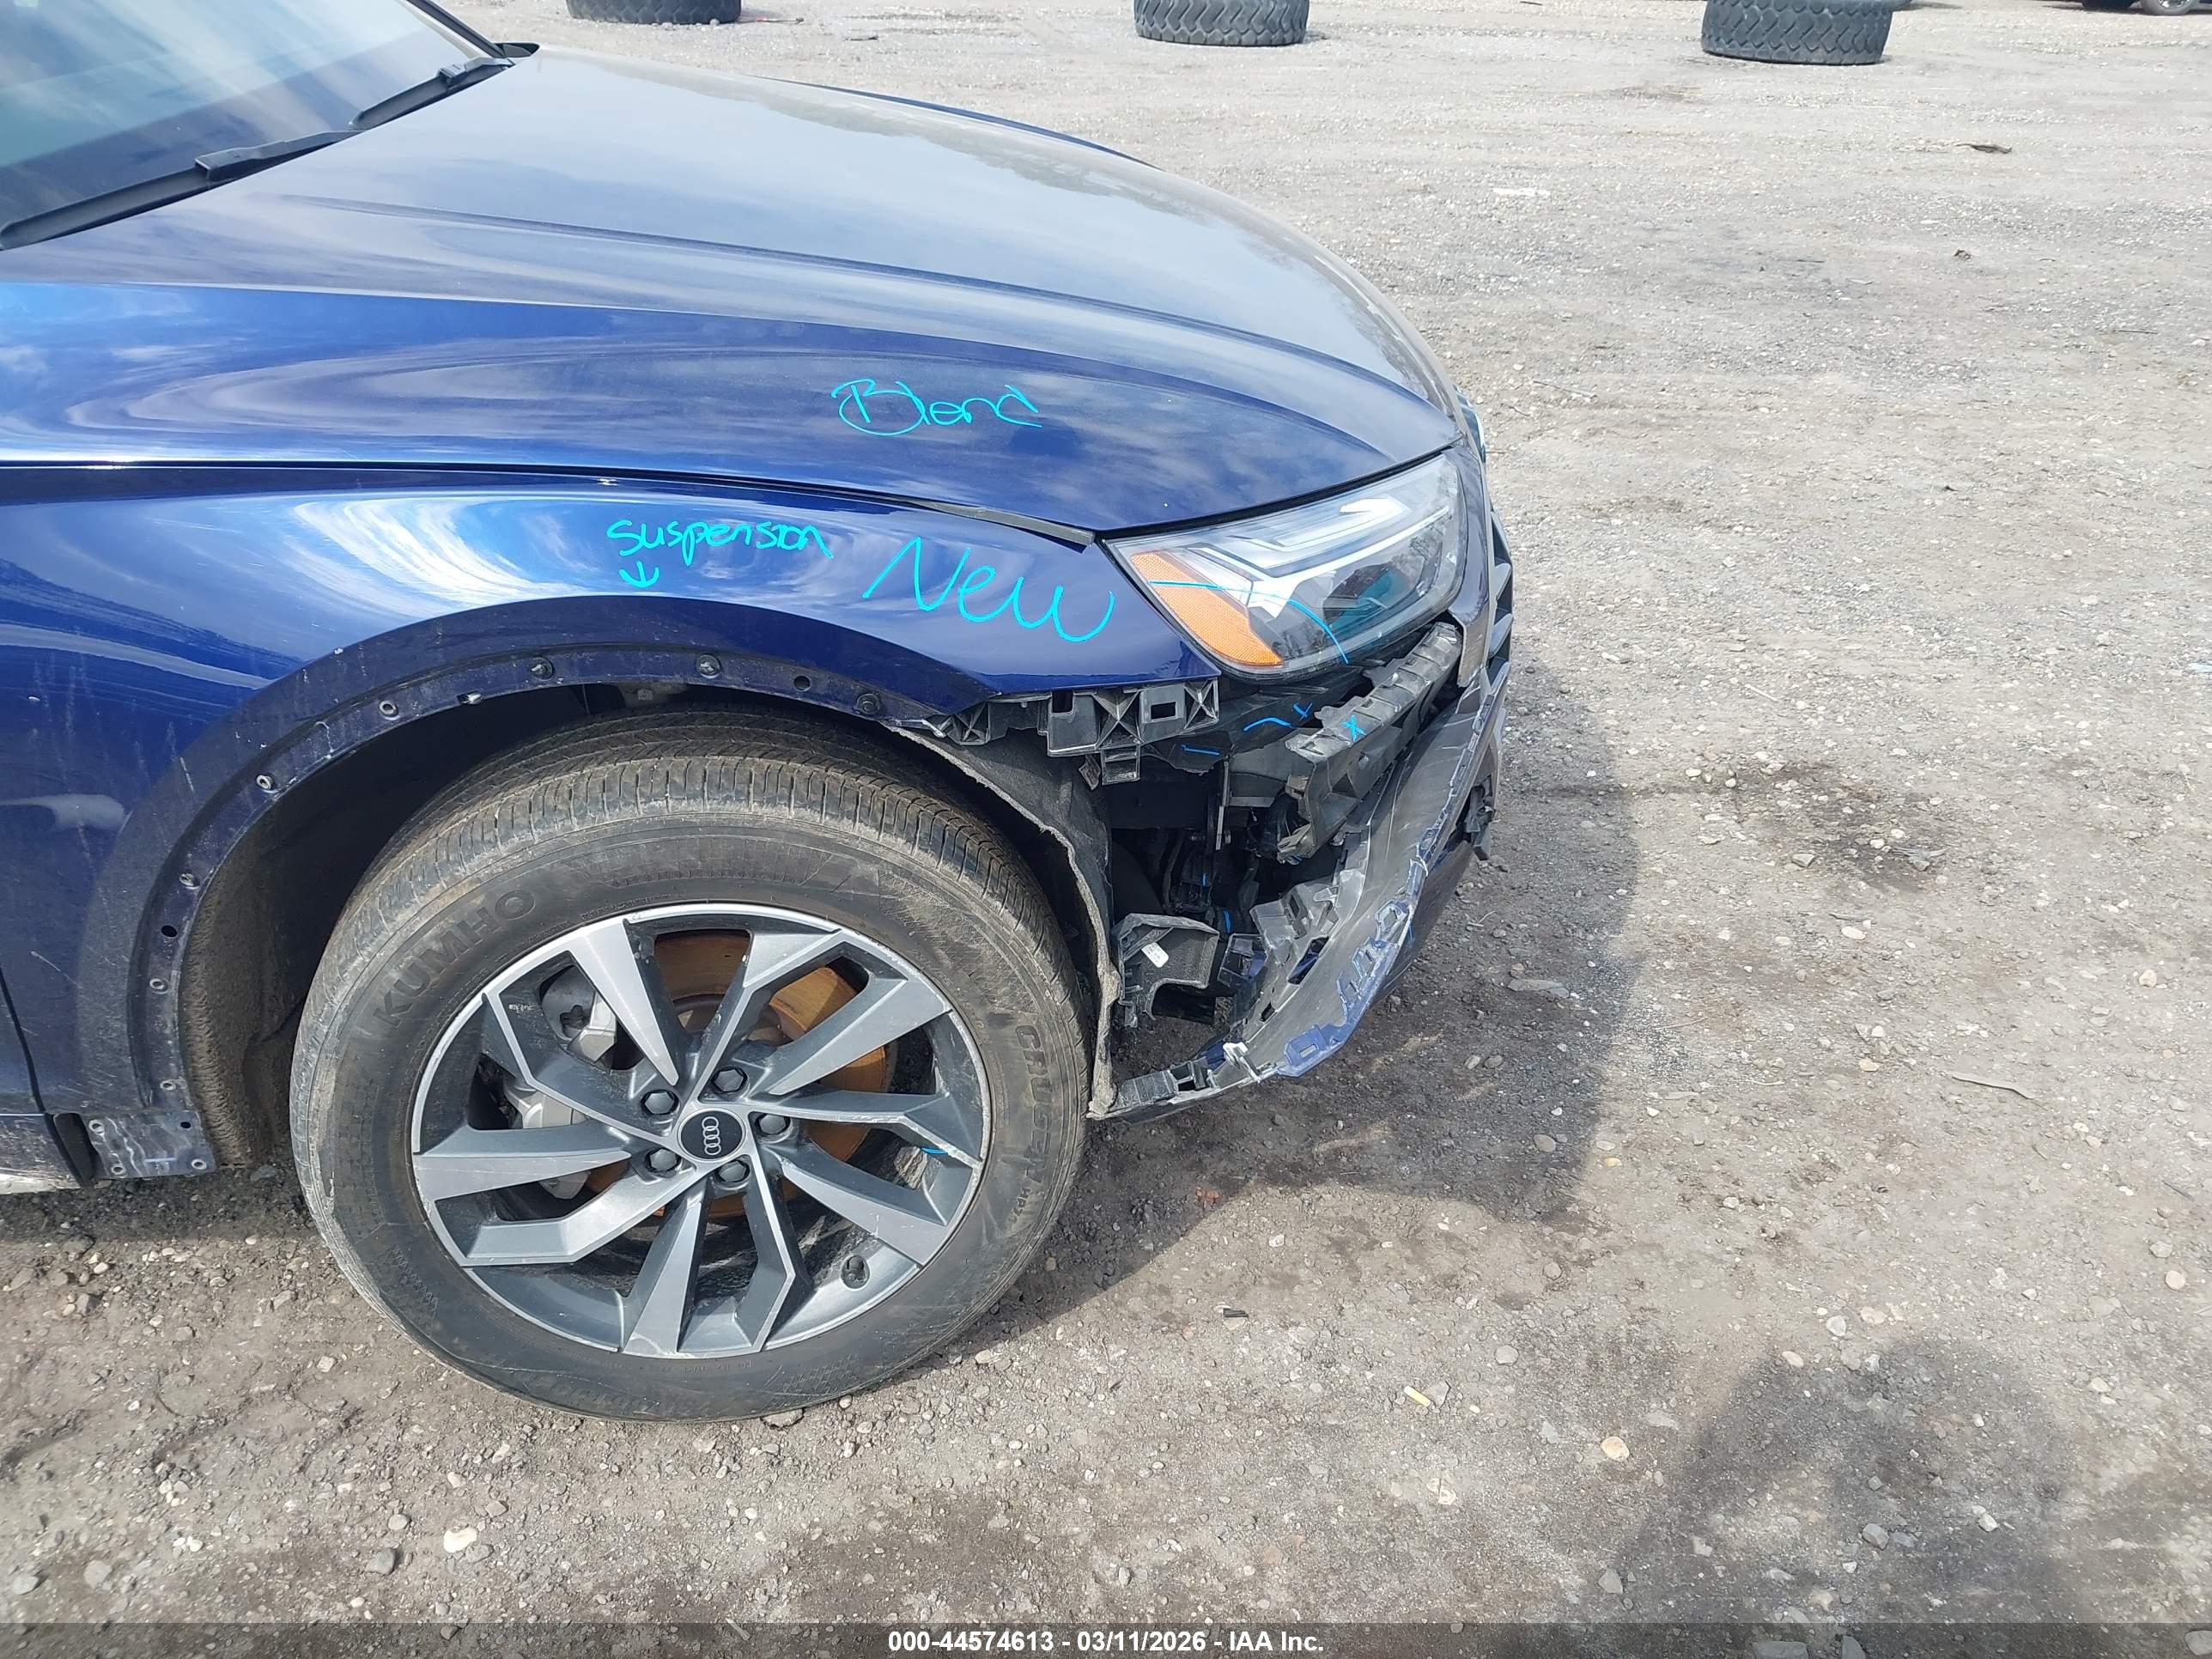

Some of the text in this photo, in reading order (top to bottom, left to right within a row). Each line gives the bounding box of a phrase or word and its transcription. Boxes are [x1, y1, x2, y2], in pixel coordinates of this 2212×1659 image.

[830, 379, 1042, 436] Blend
[862, 537, 1115, 642] New
[373, 890, 536, 1028] KUMHO
